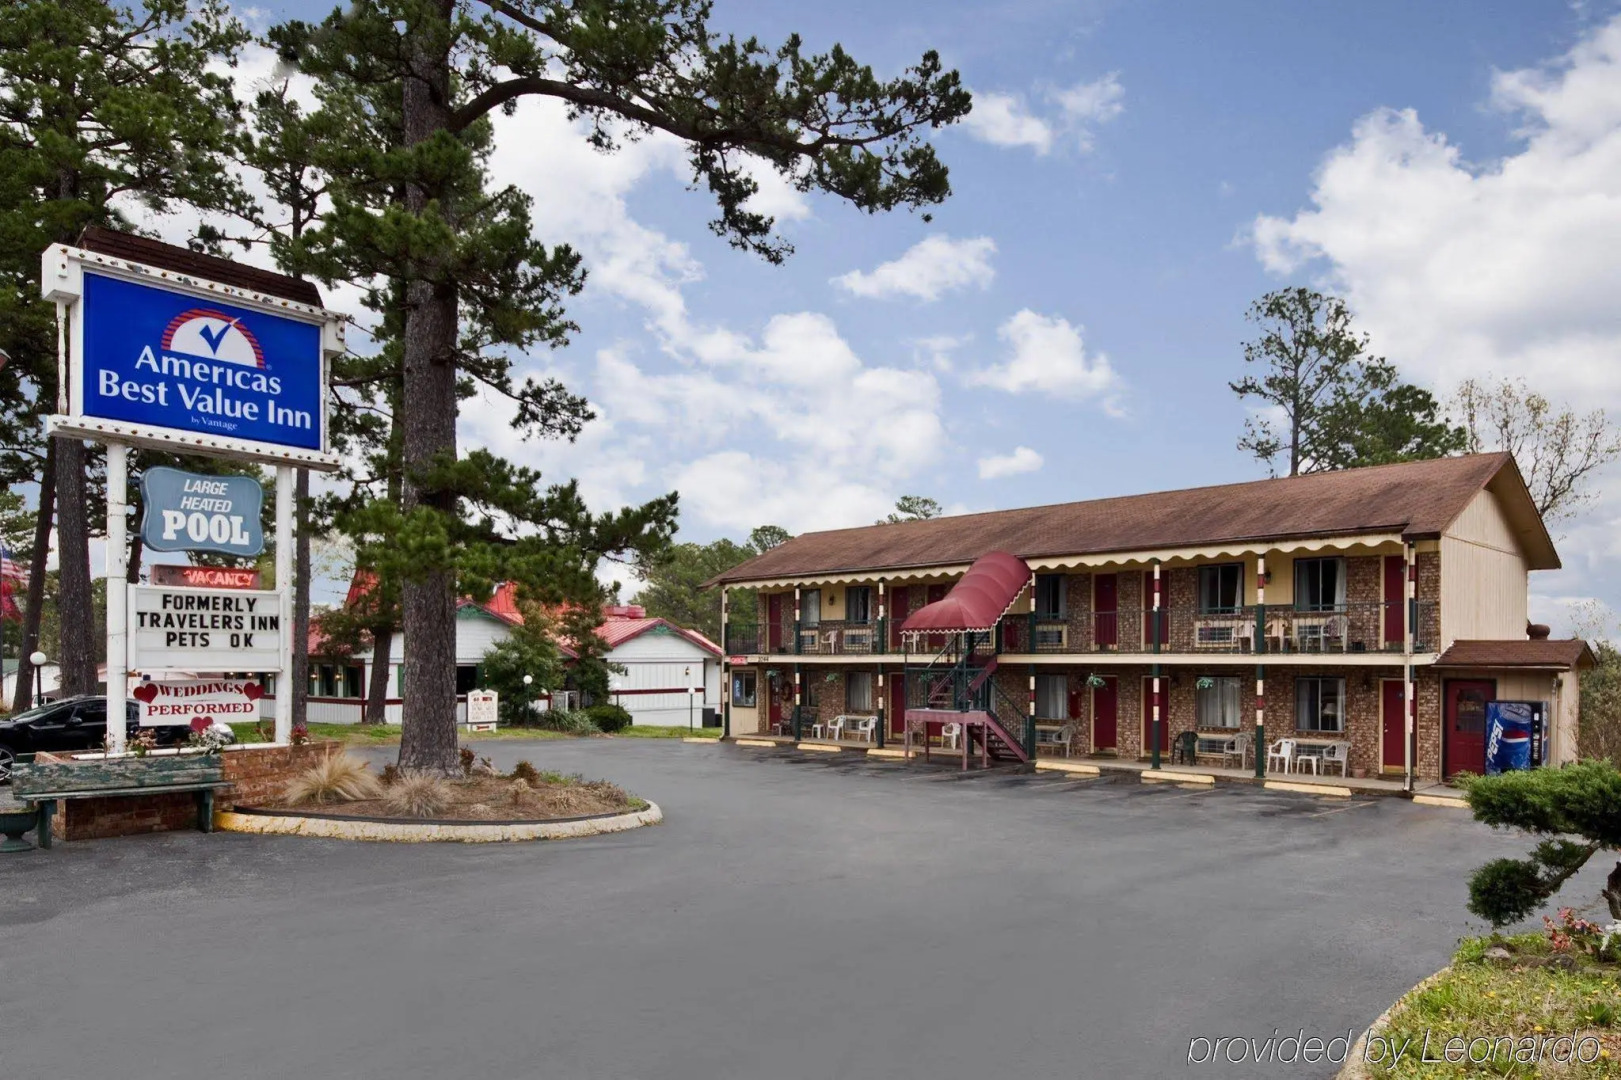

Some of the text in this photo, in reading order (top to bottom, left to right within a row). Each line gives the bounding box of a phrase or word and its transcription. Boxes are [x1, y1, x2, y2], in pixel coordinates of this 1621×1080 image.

[135, 345, 281, 394] Americas
[99, 369, 311, 430] Best Value Inn
[191, 416, 238, 431] by Vantage
[184, 479, 228, 495] LARGE
[180, 496, 232, 513] HEATED
[162, 510, 250, 545] POOL
[183, 570, 254, 586] VACANCY
[162, 594, 257, 612] FORMERLY
[137, 612, 279, 630] TRAVELERS INN
[166, 632, 253, 648] PETS OK
[158, 682, 243, 698] WEDDINGS
[147, 703, 254, 716] PERFORMED
[1487, 719, 1503, 763] PEPSI
